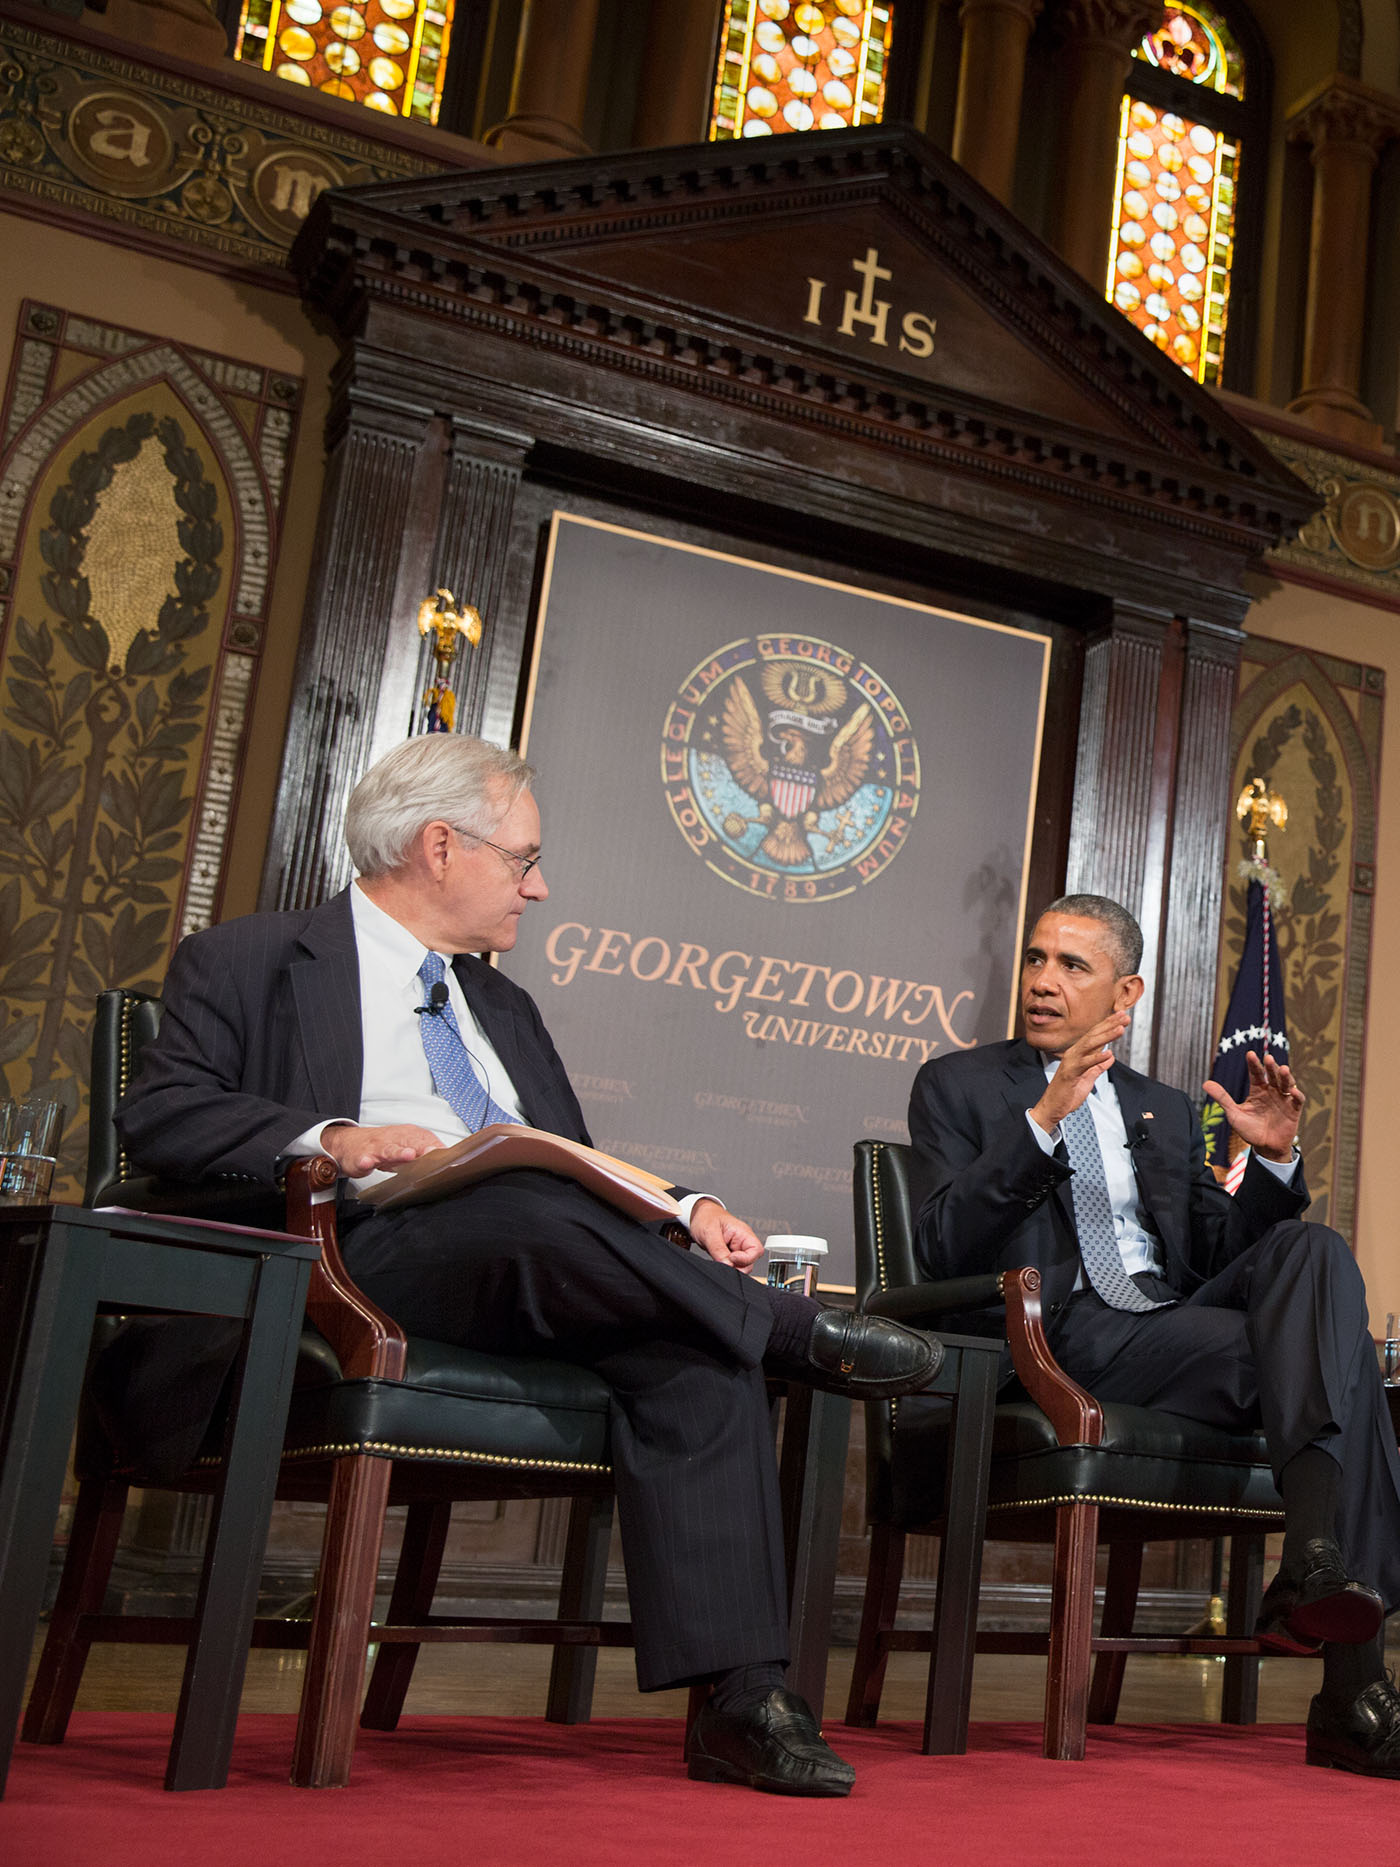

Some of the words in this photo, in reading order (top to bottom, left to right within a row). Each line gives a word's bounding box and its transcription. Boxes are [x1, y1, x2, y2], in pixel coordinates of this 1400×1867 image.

[803, 265, 937, 359] IHS
[667, 660, 726, 847] COLLEGIUM
[748, 873, 818, 898] 1789
[545, 921, 979, 1050] GEORGETOWN
[742, 1010, 940, 1064] UNIVERSITY
